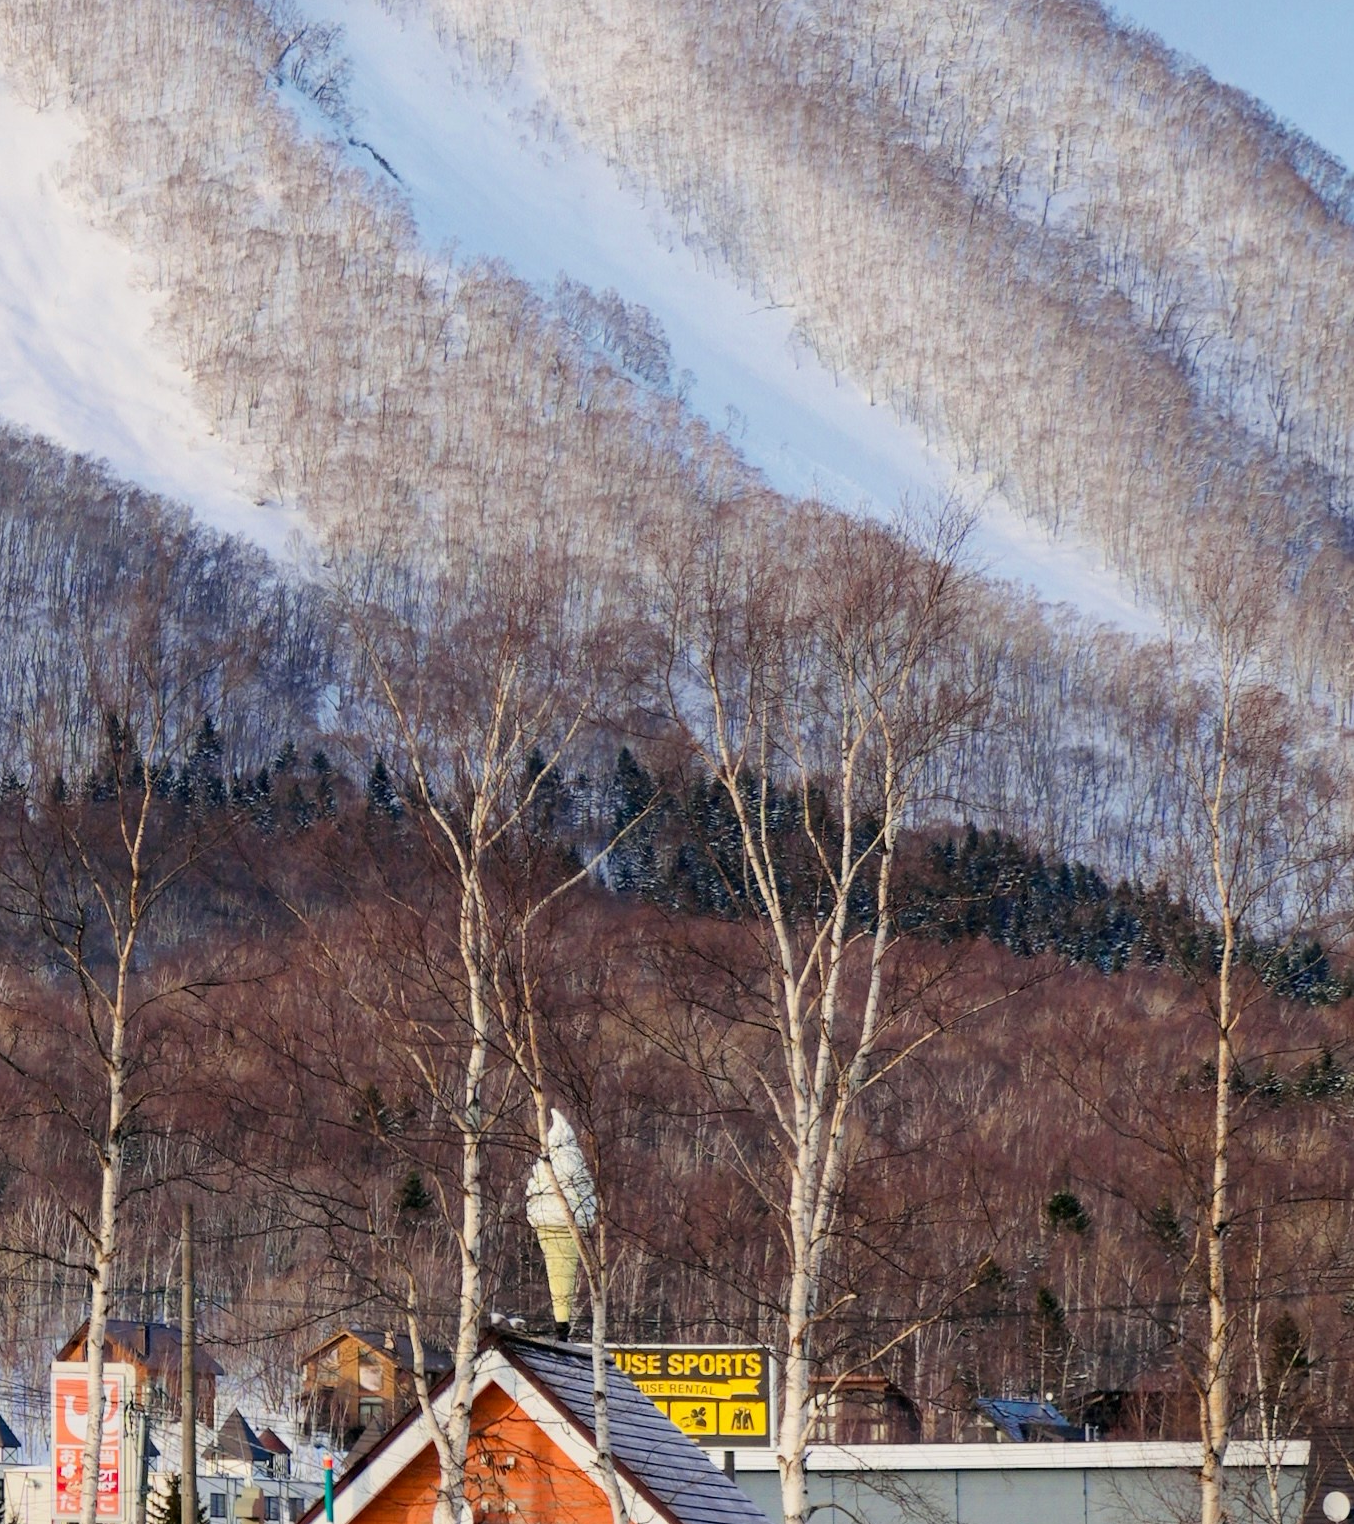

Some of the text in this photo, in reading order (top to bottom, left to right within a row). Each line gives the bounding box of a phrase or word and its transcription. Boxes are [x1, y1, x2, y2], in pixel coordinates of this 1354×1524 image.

[609, 1352, 762, 1377] USE SPORTS
[669, 1383, 716, 1395] RENTAL
[59, 1449, 115, 1465] お当
[59, 1494, 115, 1512] たこ
